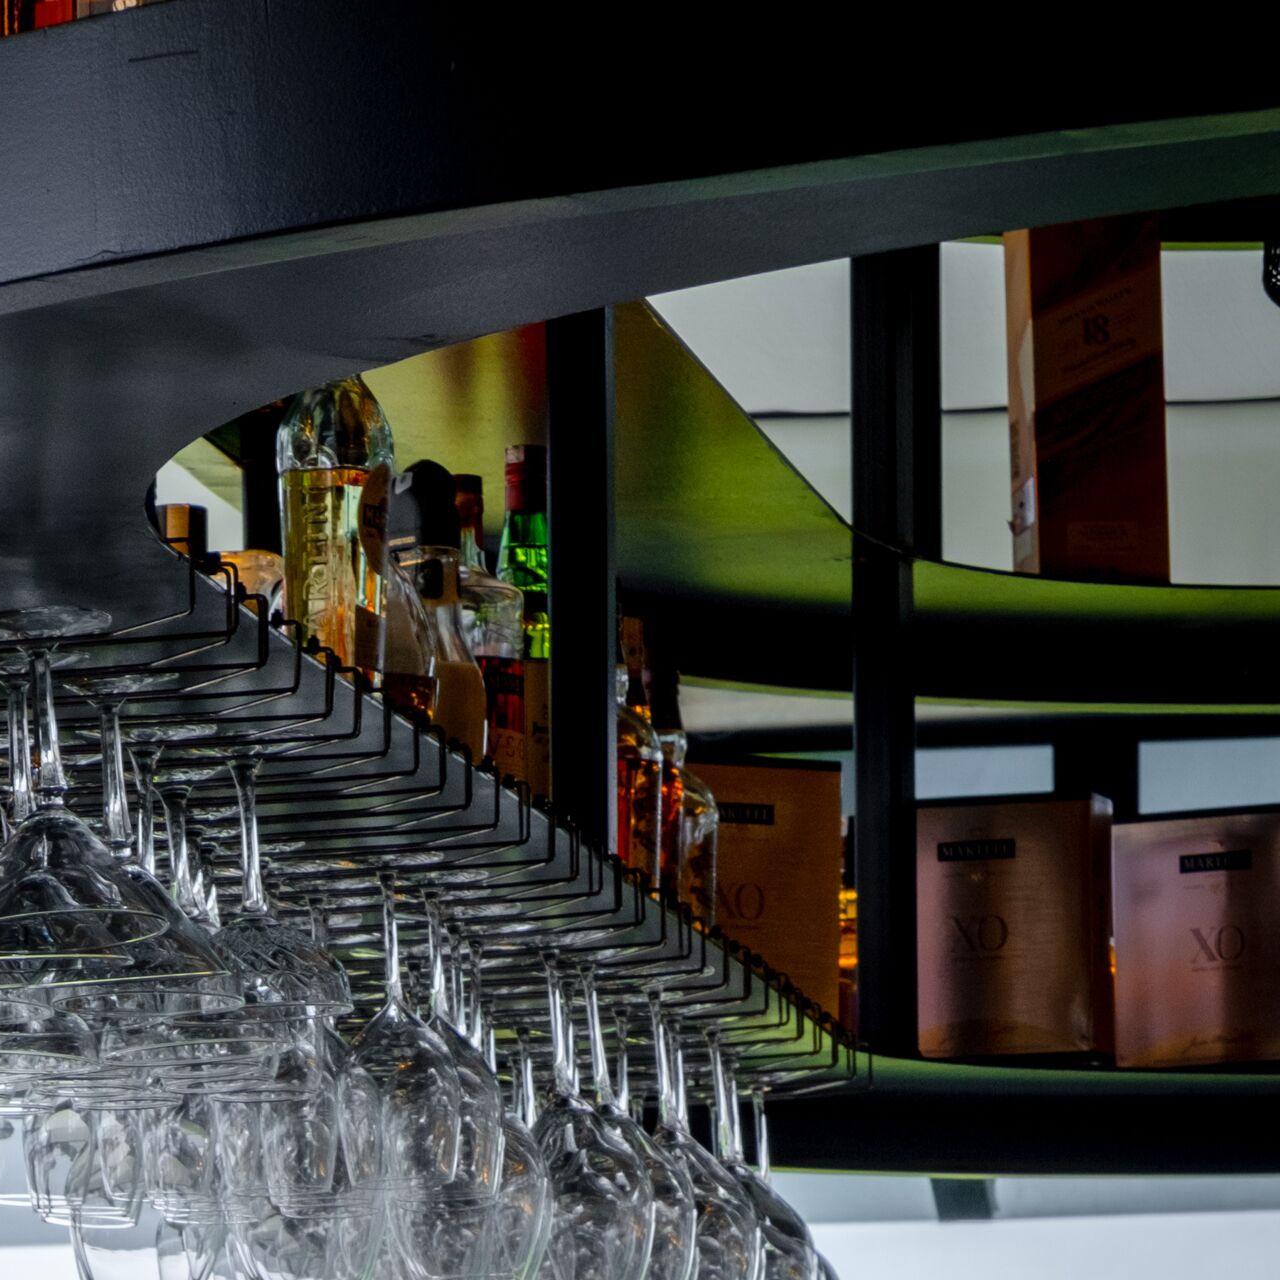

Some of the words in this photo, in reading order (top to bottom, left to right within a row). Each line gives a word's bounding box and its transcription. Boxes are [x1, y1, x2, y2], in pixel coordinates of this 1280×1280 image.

[1083, 314, 1110, 345] 18
[950, 914, 1009, 953] XO
[1190, 924, 1246, 965] XO
